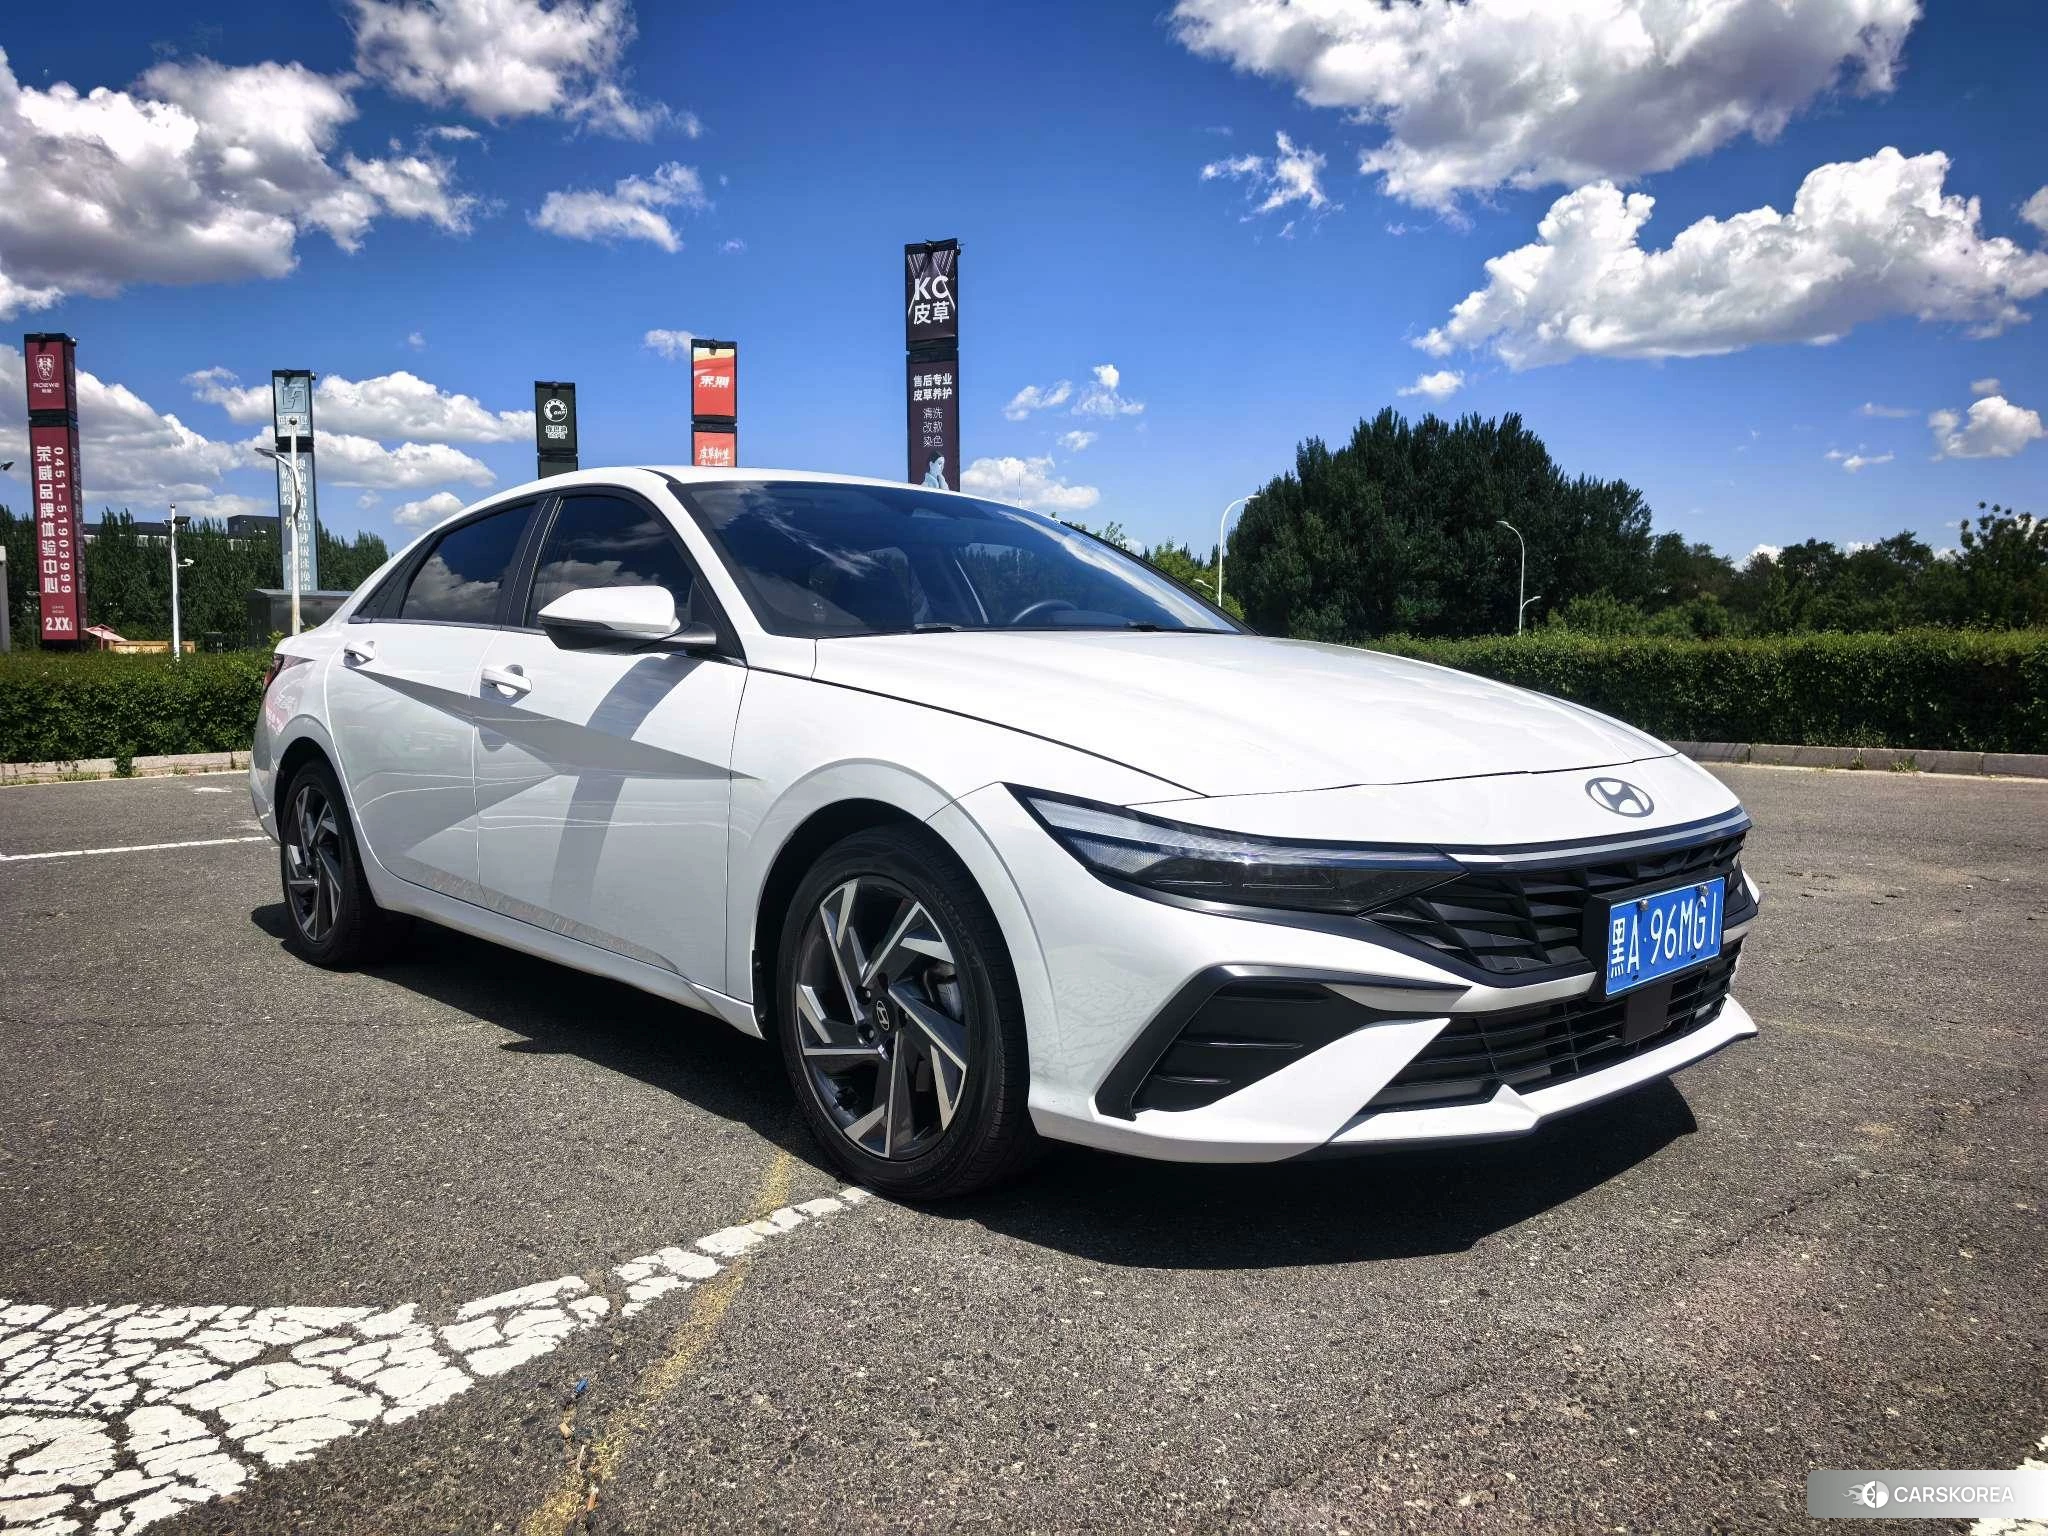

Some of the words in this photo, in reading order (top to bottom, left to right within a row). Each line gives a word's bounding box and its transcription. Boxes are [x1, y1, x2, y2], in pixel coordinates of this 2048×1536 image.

[914, 275, 949, 301] KC
[913, 301, 950, 325] 皮草
[913, 373, 953, 387] 售后专业
[913, 387, 953, 401] 皮草养护
[922, 407, 943, 419] 清洗
[922, 421, 943, 433] 改款
[923, 435, 944, 448] 染色
[54, 447, 71, 593] 0451-51903999
